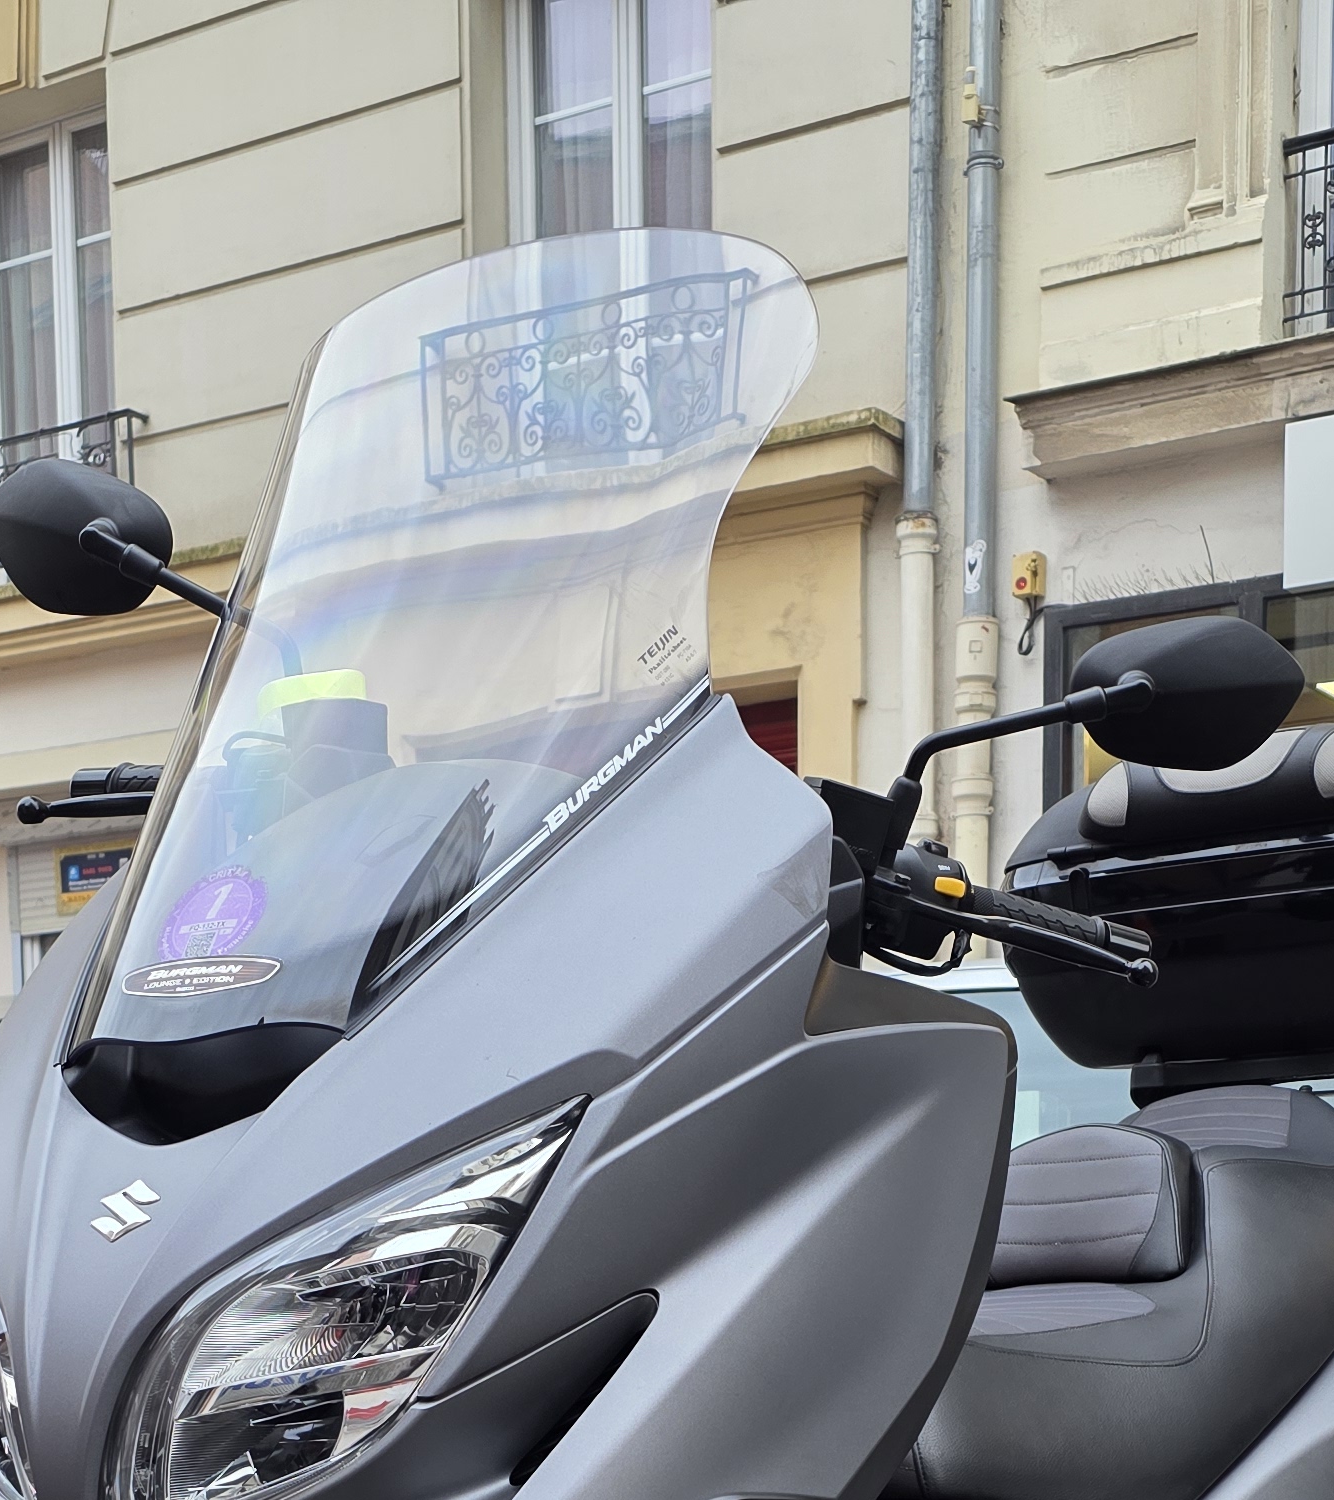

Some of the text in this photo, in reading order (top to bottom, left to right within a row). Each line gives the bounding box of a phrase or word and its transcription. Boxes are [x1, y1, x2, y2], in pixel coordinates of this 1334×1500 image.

[637, 625, 678, 665] TEIJIN
[542, 716, 664, 834] BURGMAN
[147, 964, 243, 981] BURGMAN
[192, 975, 235, 985] EDITION
